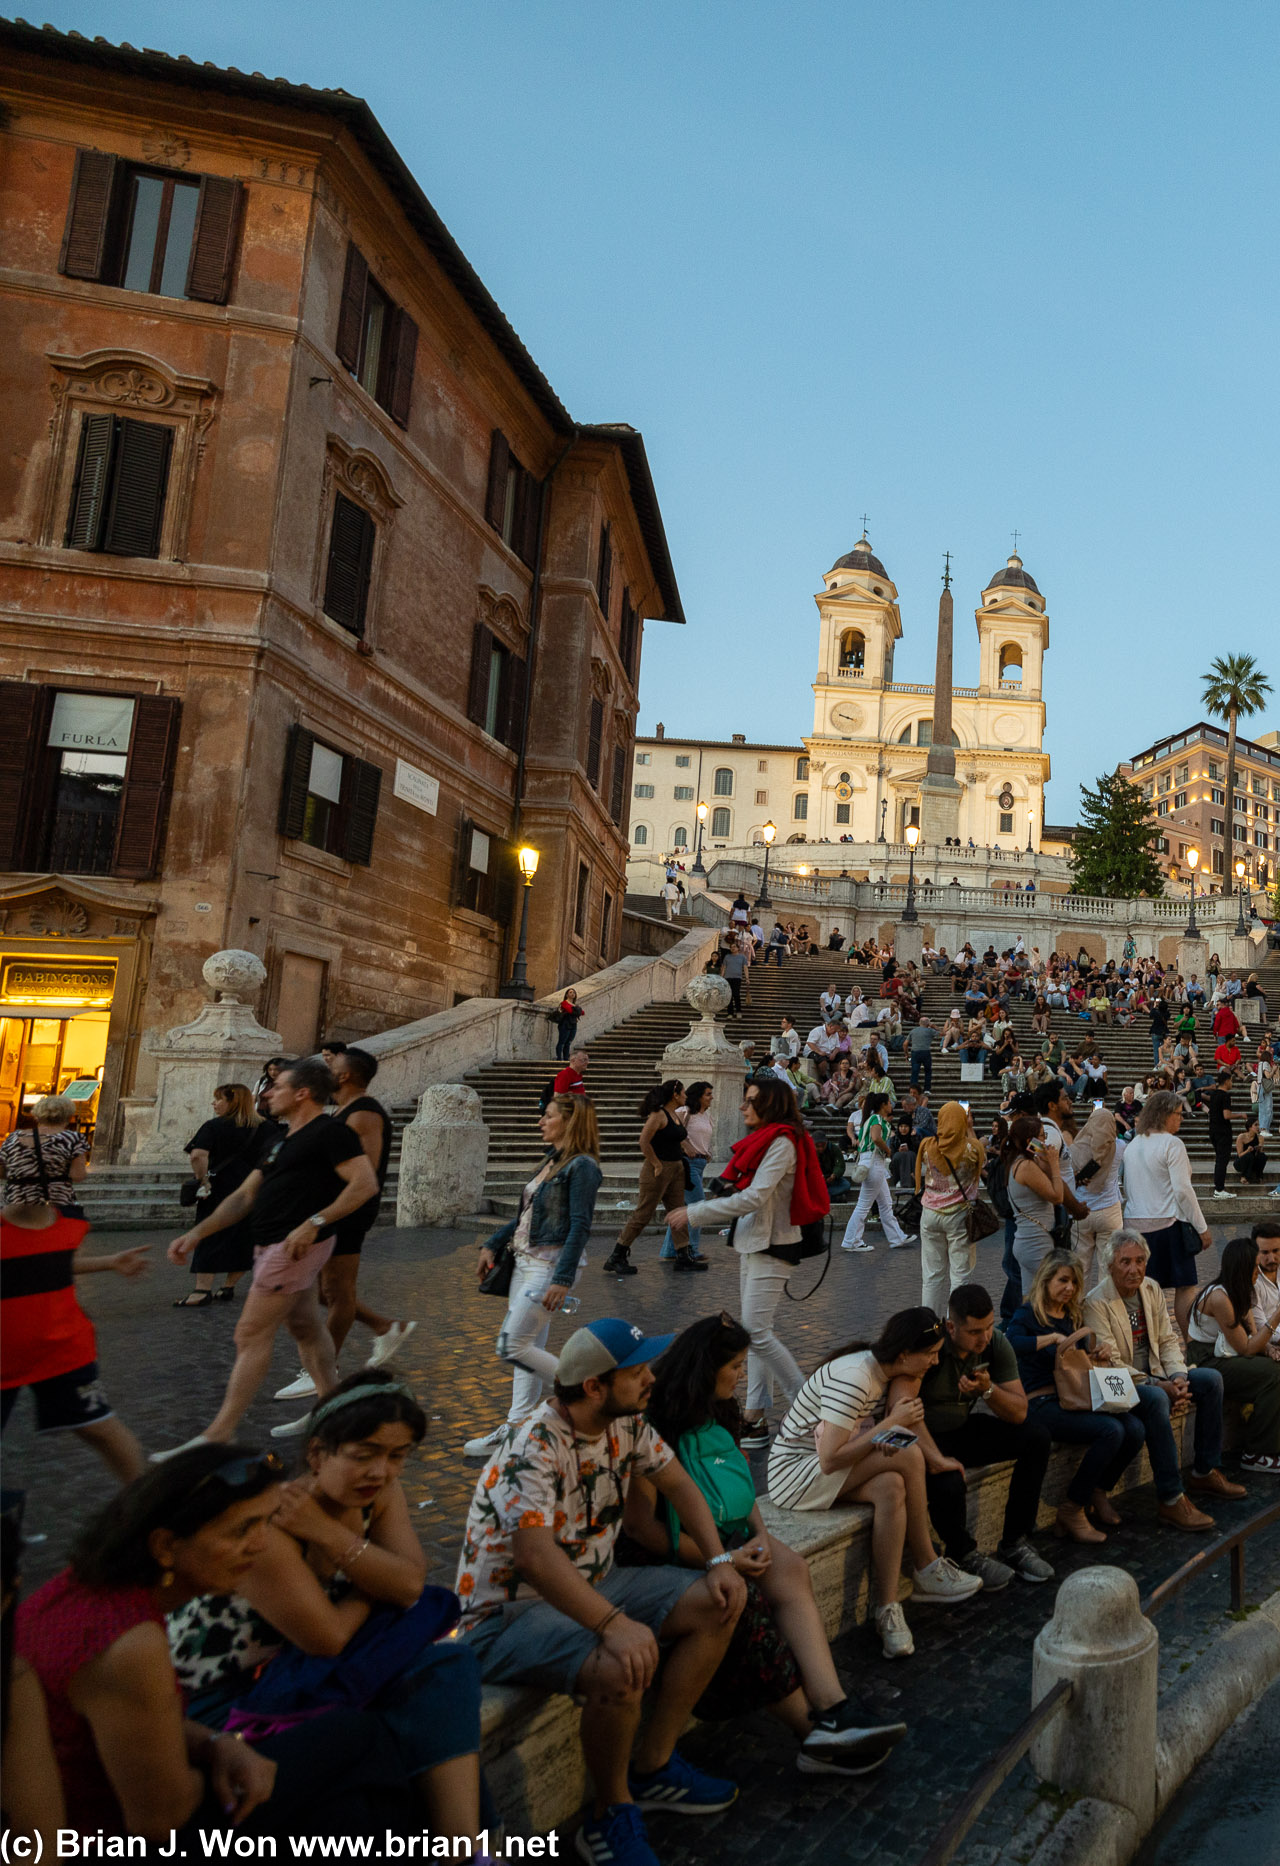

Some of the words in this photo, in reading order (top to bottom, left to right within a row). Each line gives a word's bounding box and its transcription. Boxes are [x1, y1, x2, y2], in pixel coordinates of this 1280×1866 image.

[61, 732, 118, 747] FURLA
[13, 972, 109, 985] BABINGTONS
[15, 985, 37, 993] TEA
[41, 986, 67, 994] ROOM
